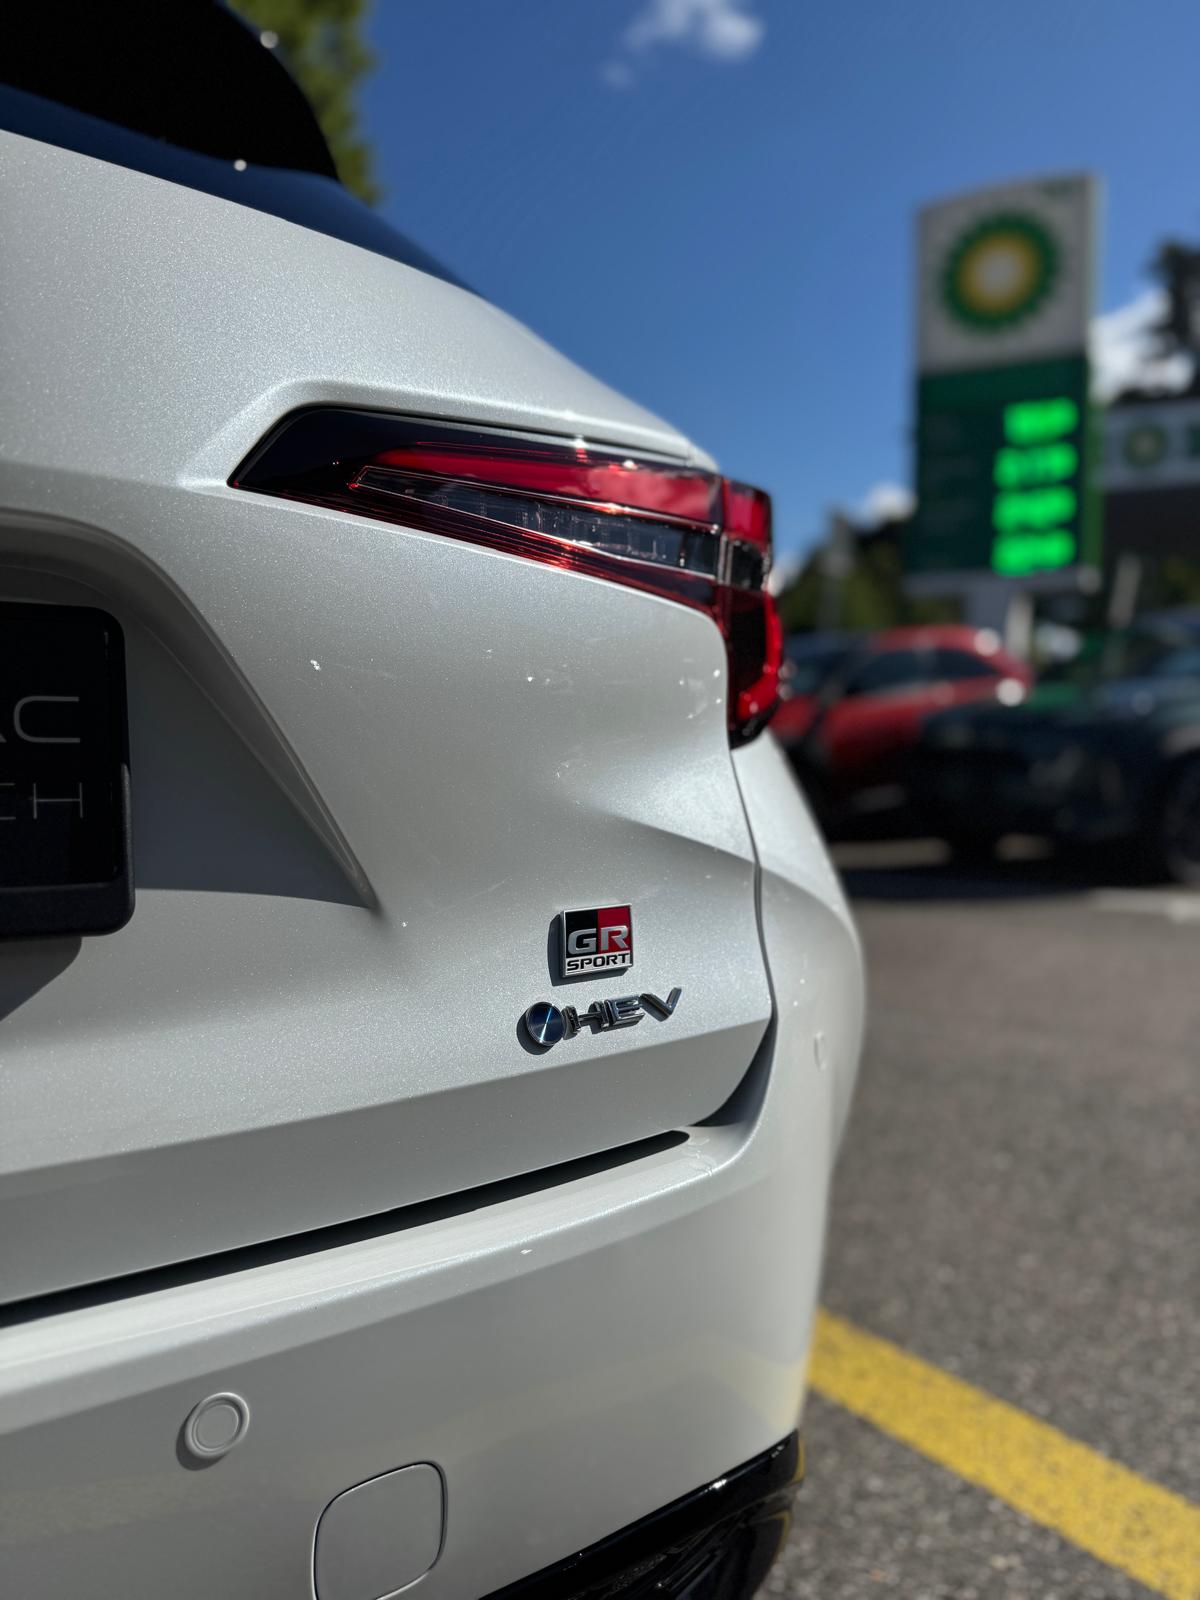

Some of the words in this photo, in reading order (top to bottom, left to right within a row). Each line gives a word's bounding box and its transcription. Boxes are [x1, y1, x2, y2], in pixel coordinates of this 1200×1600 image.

[0, 695, 81, 744] C
[568, 925, 629, 954] GR
[567, 953, 630, 971] SPORT
[561, 987, 682, 1034] HEV
